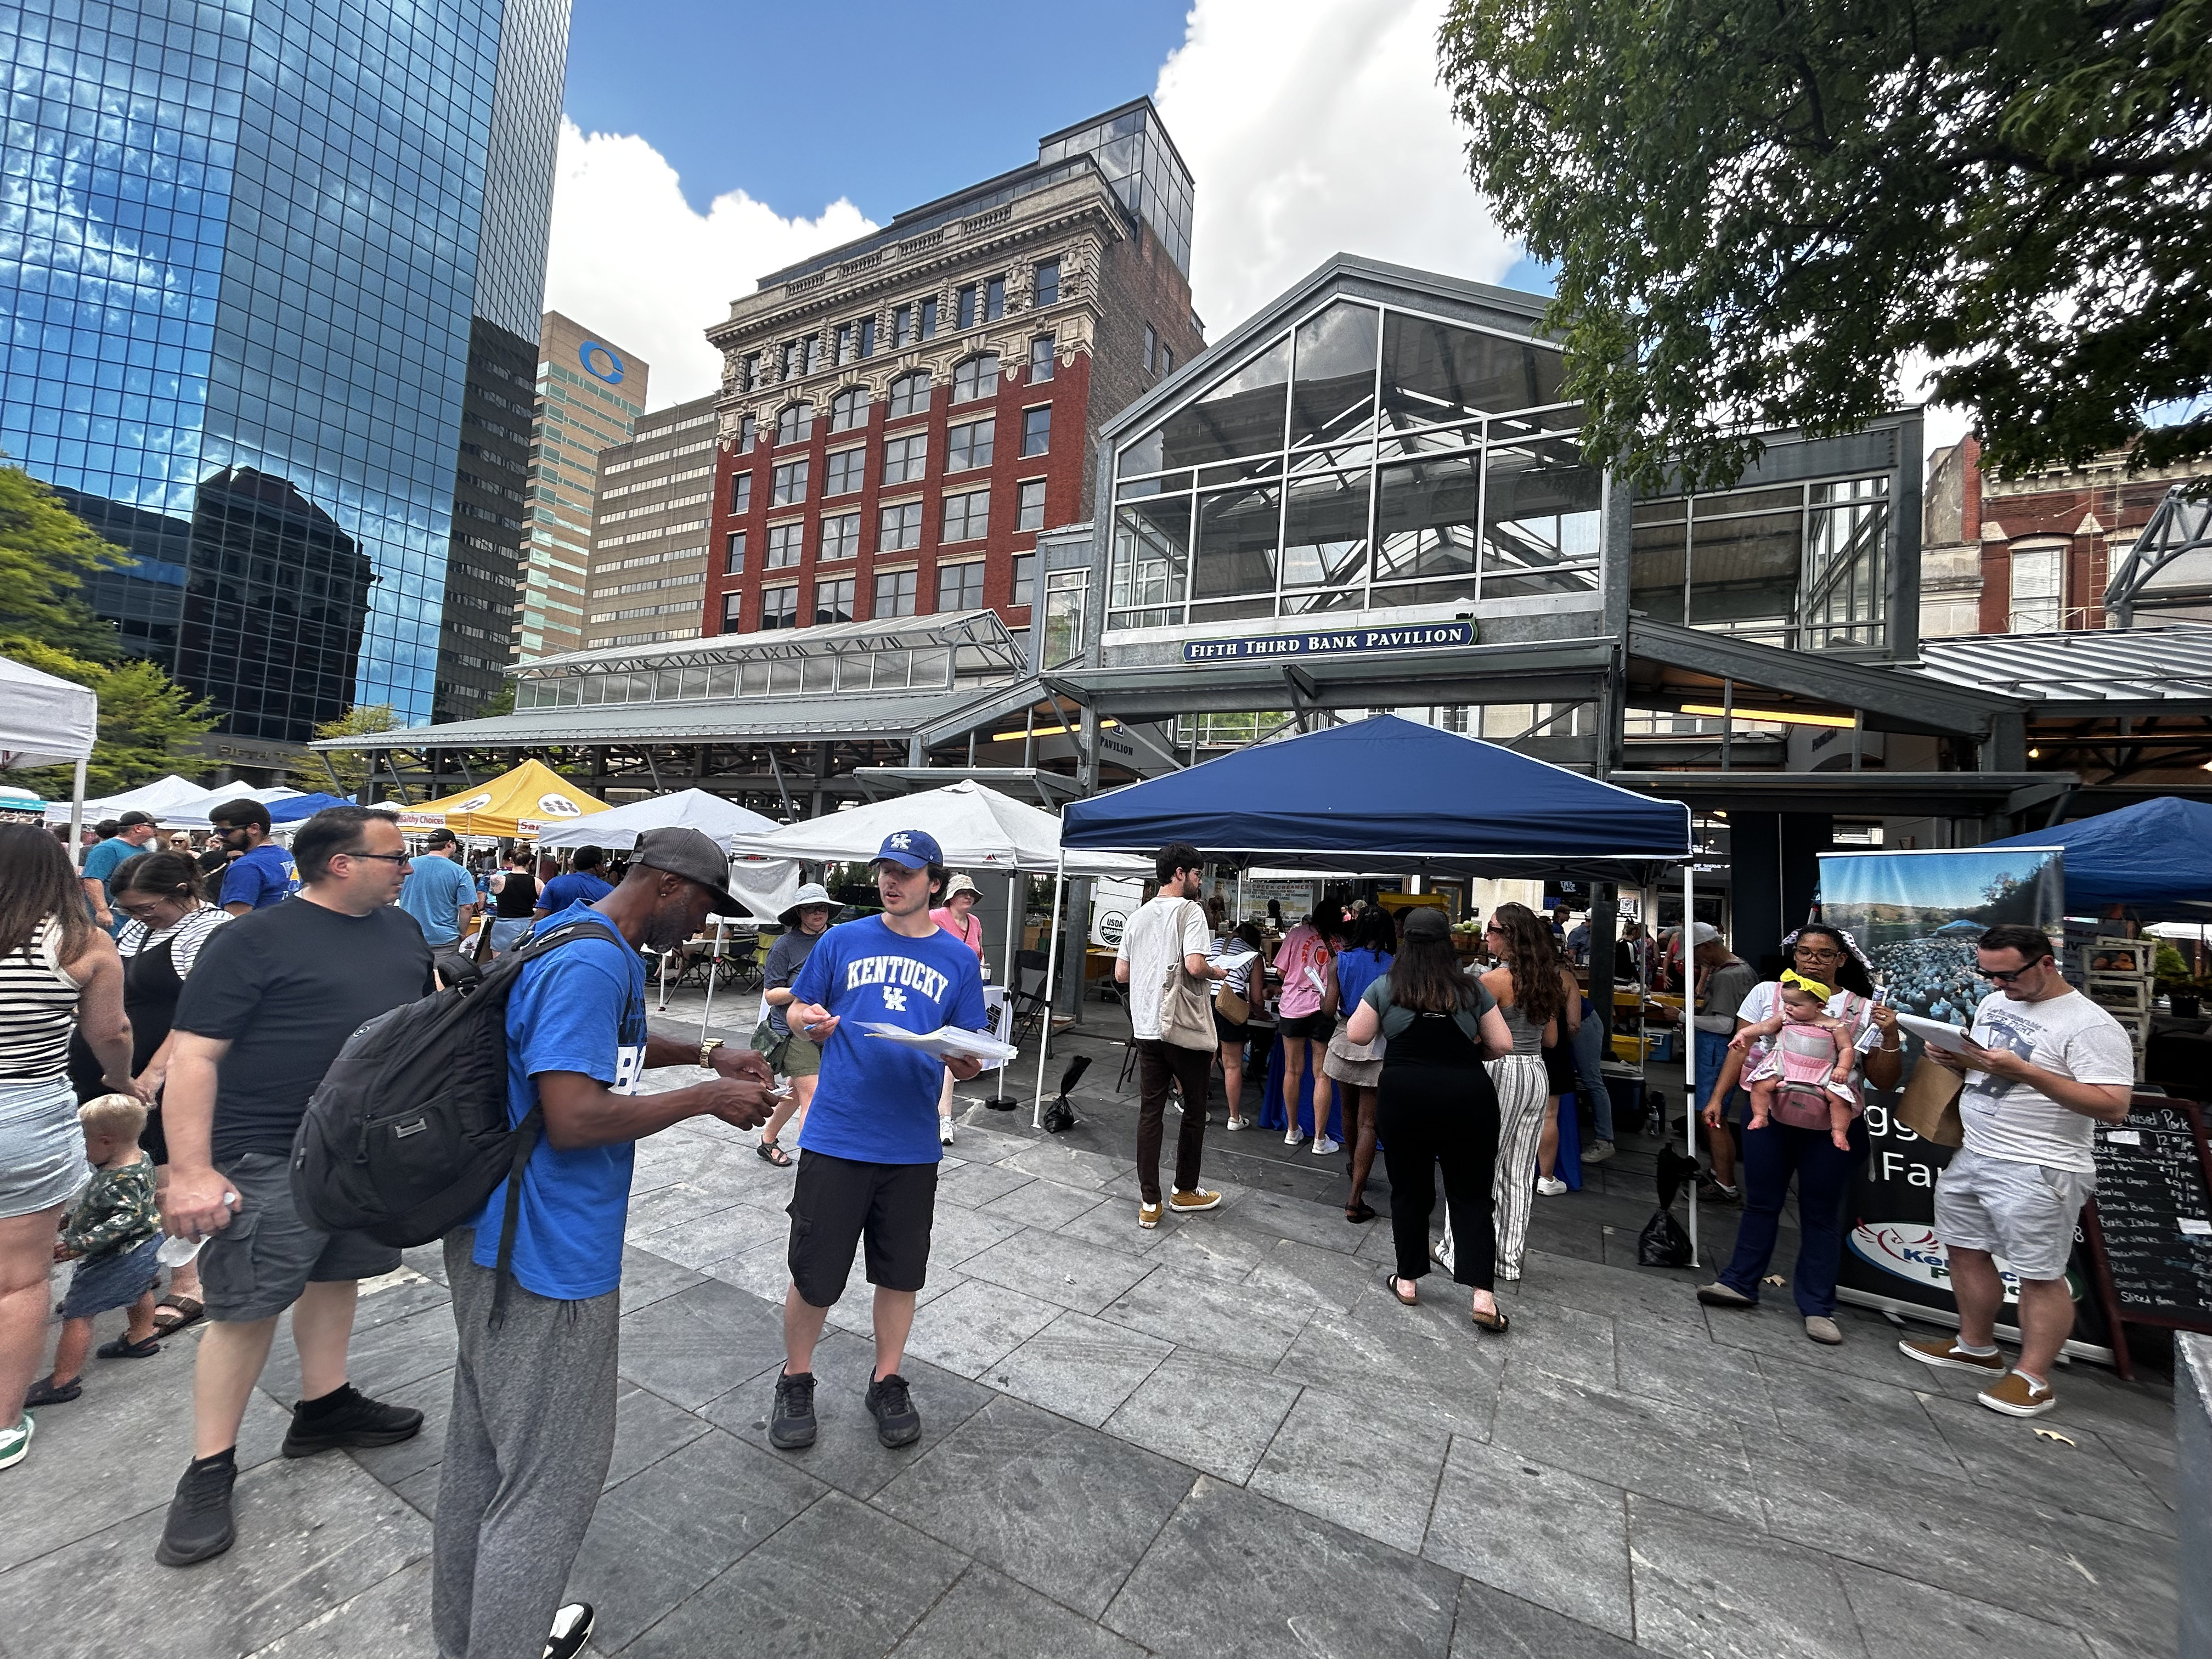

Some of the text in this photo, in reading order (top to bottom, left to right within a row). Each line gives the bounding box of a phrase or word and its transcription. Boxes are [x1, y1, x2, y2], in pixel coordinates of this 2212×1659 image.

[1190, 628, 1463, 658] FIFTH THIRD BANK PAVILION
[1100, 736, 1133, 756] PAVILION
[397, 814, 444, 825] ealthy Choices
[1107, 918, 1123, 928] USDA
[847, 955, 949, 1005] KENTUCKY
[883, 985, 907, 1012] UK
